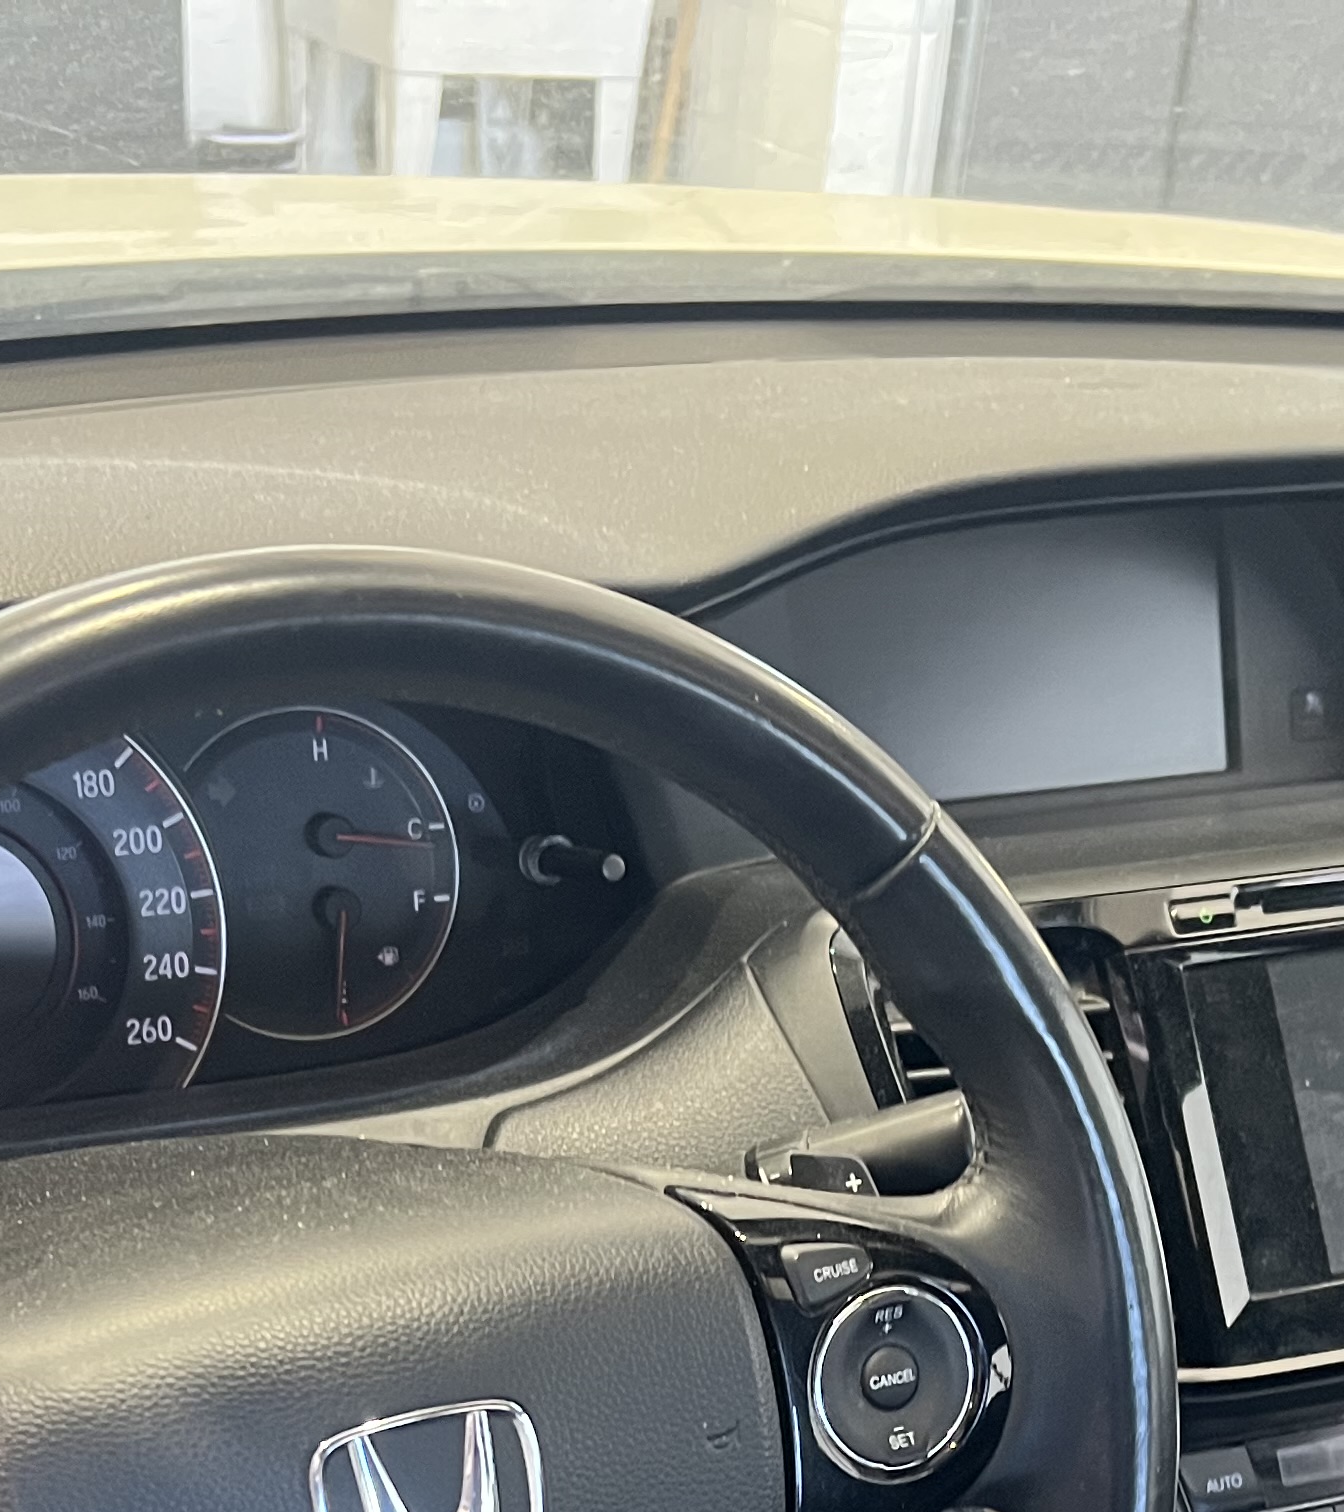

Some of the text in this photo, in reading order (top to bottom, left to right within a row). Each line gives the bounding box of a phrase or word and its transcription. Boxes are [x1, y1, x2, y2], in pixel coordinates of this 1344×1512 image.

[312, 738, 328, 762] H
[73, 769, 116, 799] 180
[113, 825, 163, 857] 200
[408, 817, 423, 840] C
[139, 887, 187, 918] 220
[413, 888, 425, 911] F
[143, 951, 190, 981] 240
[126, 1016, 173, 1047] 260
[813, 1257, 859, 1283] CRUISE
[869, 1368, 916, 1390] CANCEL
[888, 1431, 915, 1450] SET
[1206, 1472, 1243, 1494] AUTO
